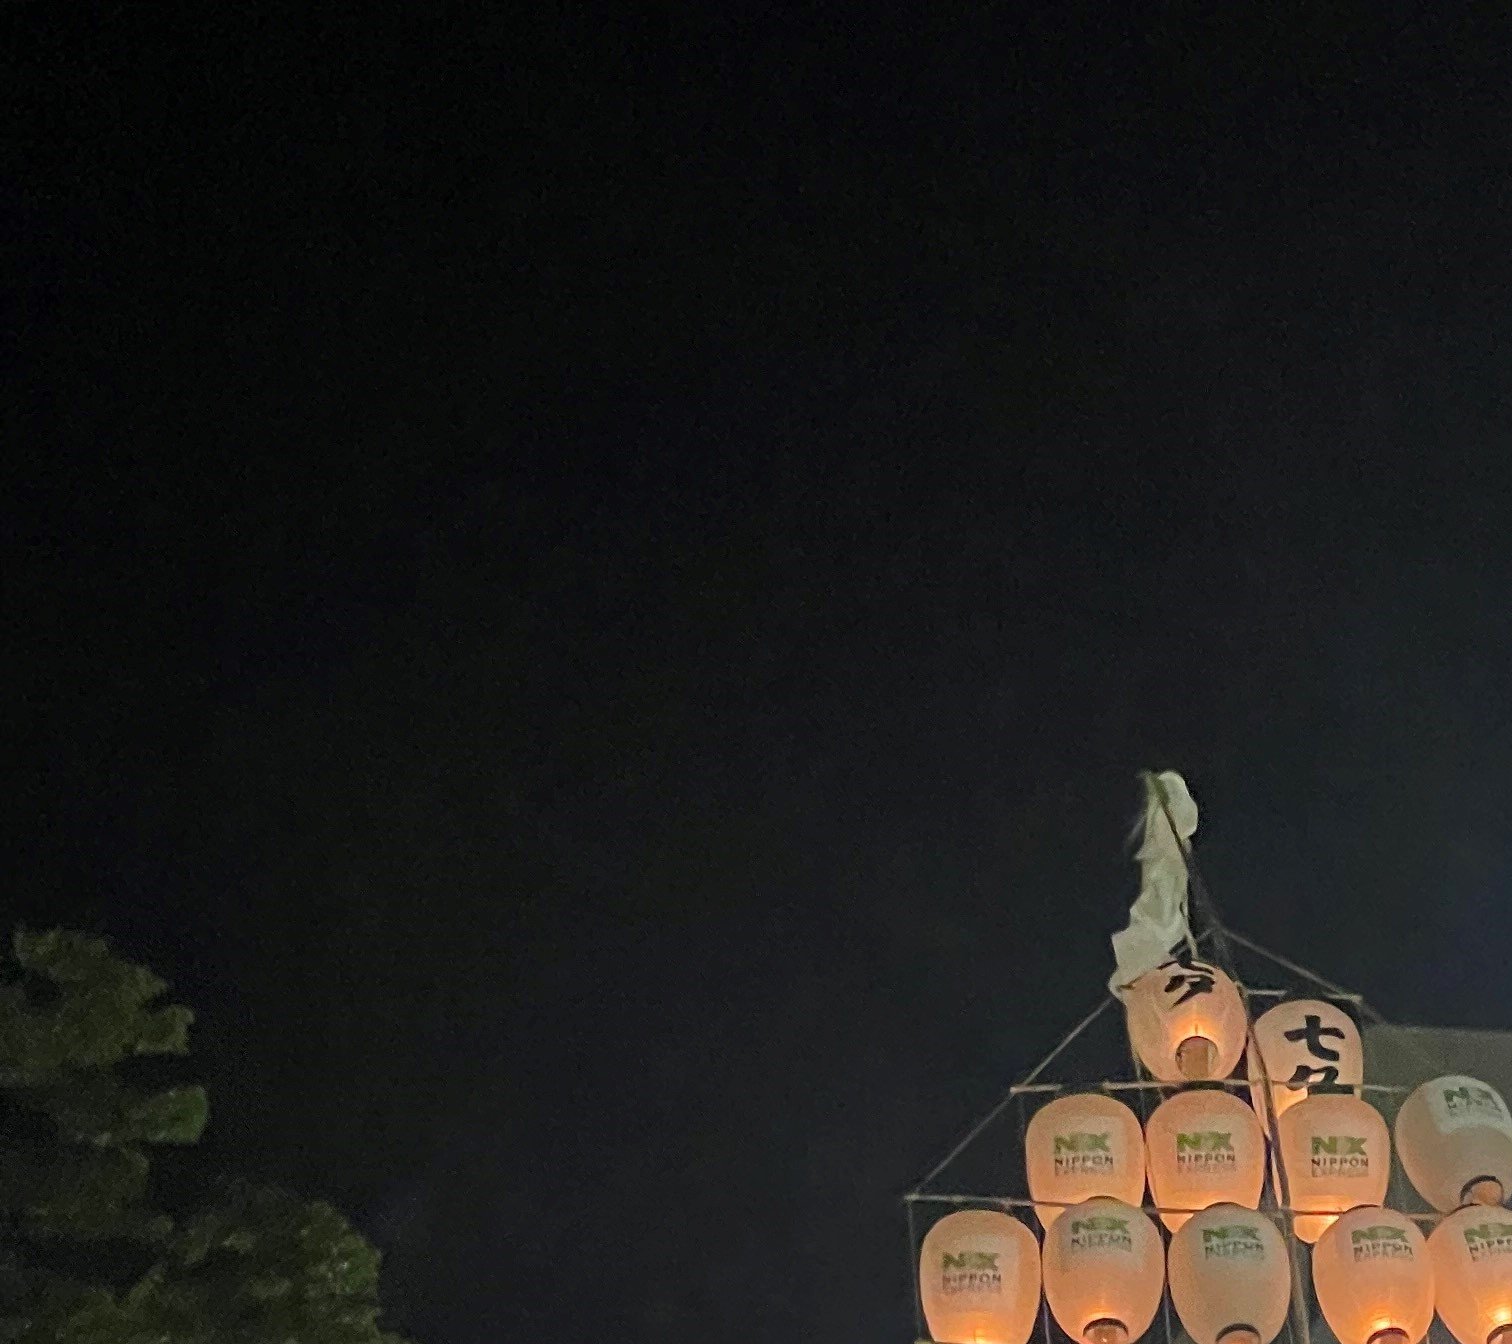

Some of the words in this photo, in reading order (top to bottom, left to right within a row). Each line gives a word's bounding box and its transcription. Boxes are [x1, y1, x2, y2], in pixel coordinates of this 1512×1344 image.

[1055, 1132, 1110, 1153] NX
[1177, 1131, 1235, 1151] NX
[1311, 1136, 1367, 1155] NX
[1312, 1157, 1368, 1168] NIPPON
[1071, 1217, 1129, 1234] NX
[1203, 1226, 1261, 1241] NX
[1352, 1226, 1407, 1243] NX
[942, 1252, 999, 1270] NX
